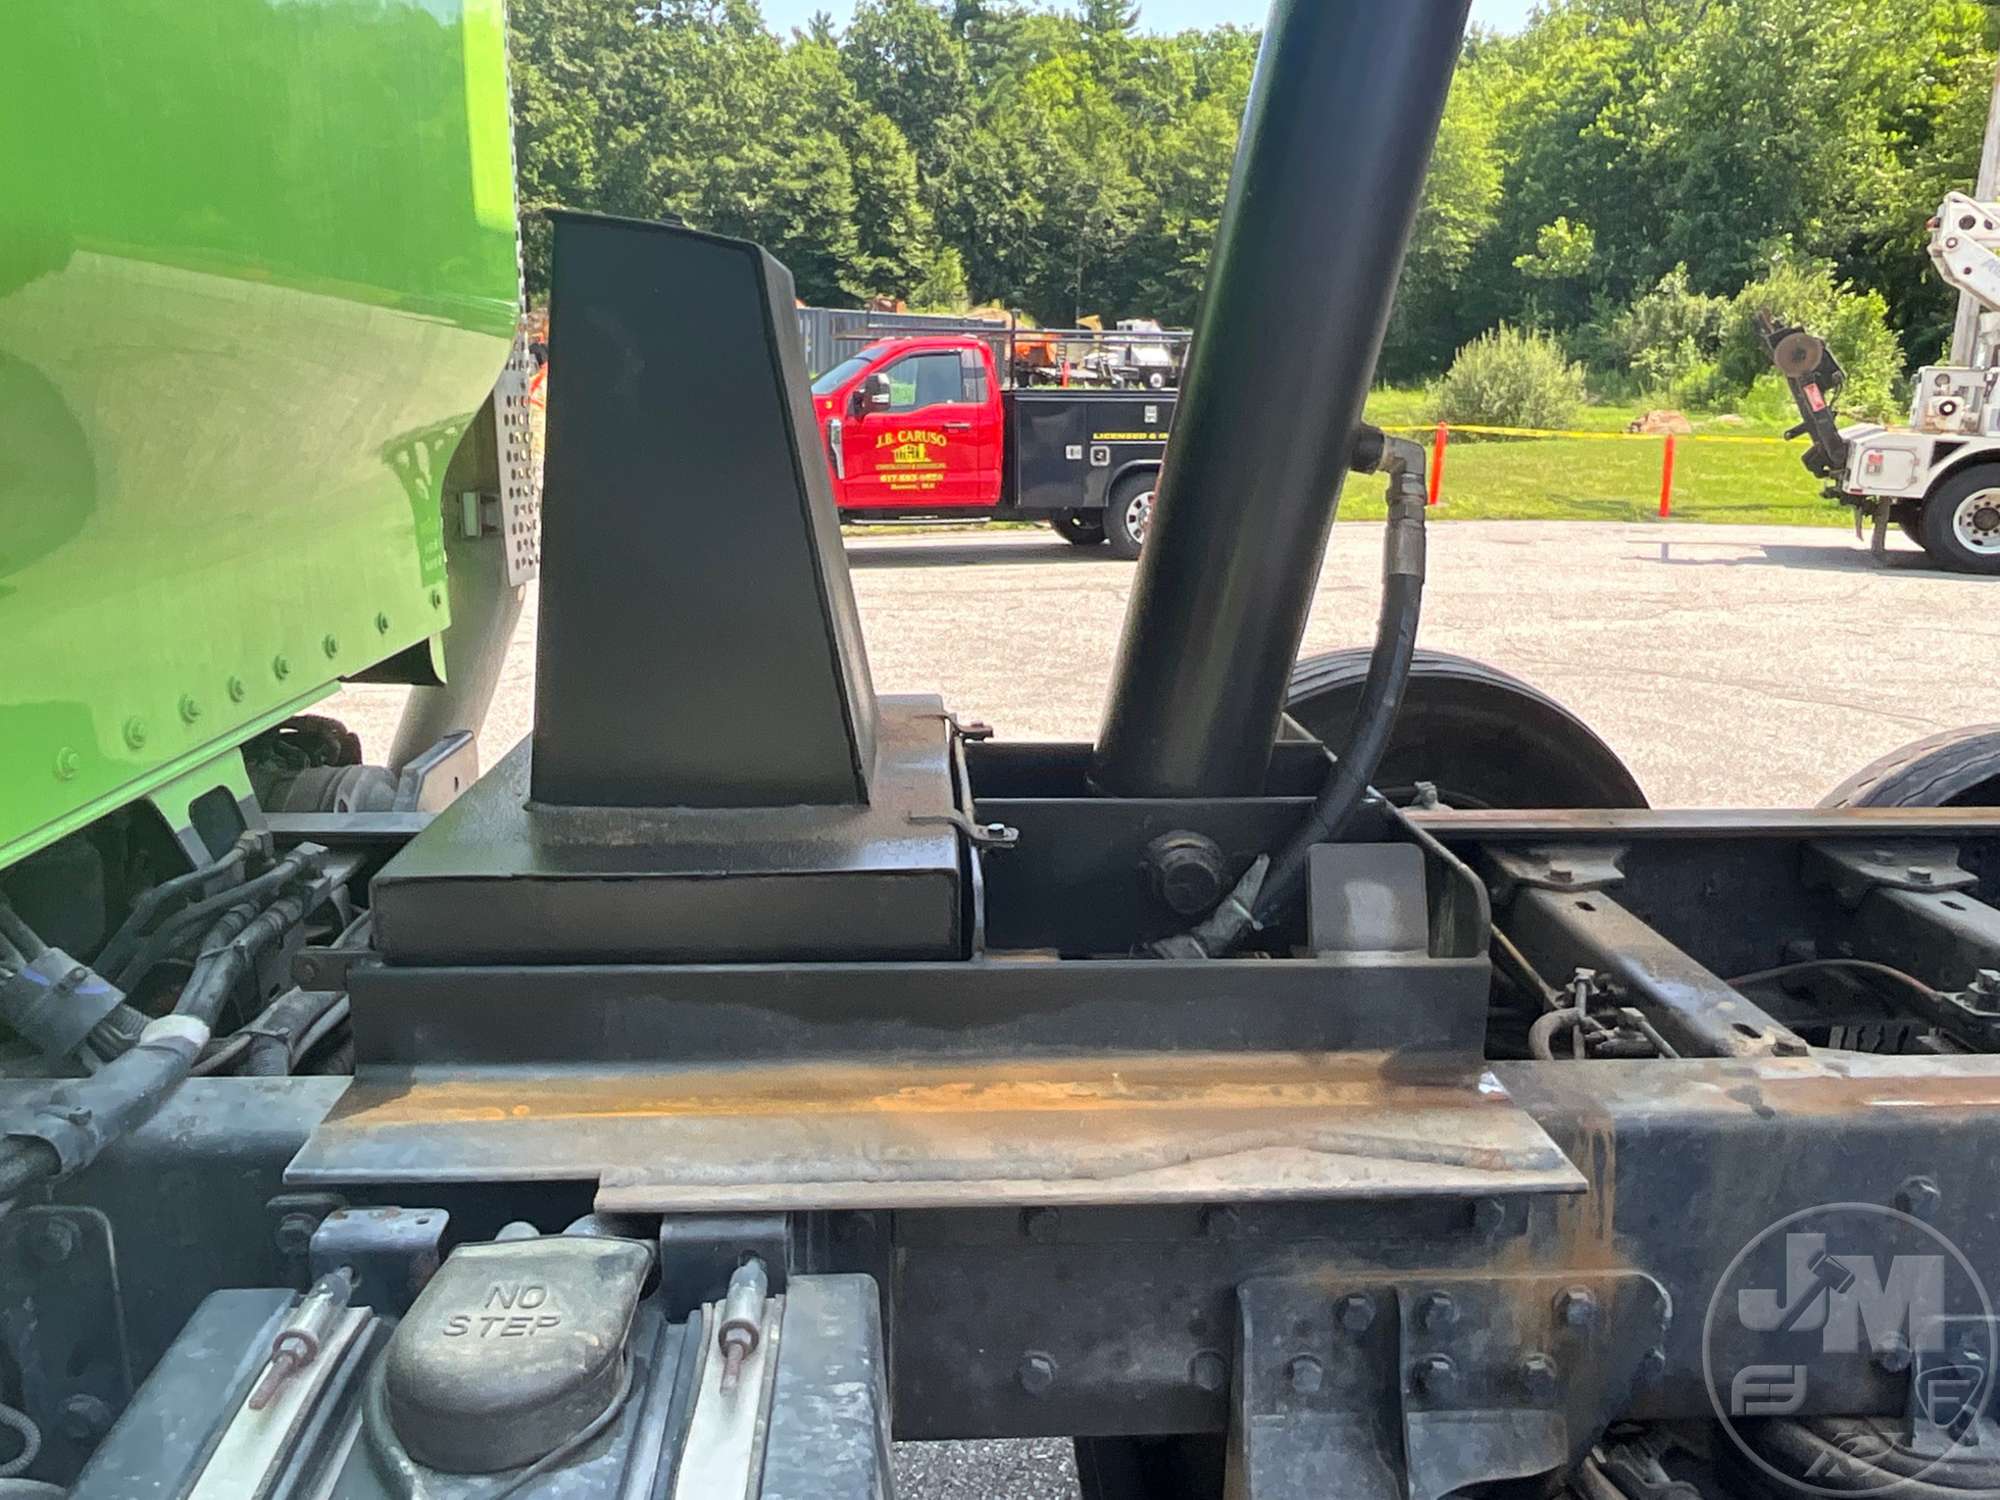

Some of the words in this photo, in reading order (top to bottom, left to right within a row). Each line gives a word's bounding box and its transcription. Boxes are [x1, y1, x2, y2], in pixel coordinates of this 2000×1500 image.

[897, 430, 948, 448] CARUSO
[484, 1284, 549, 1309] NO
[442, 1313, 561, 1338] STEP
